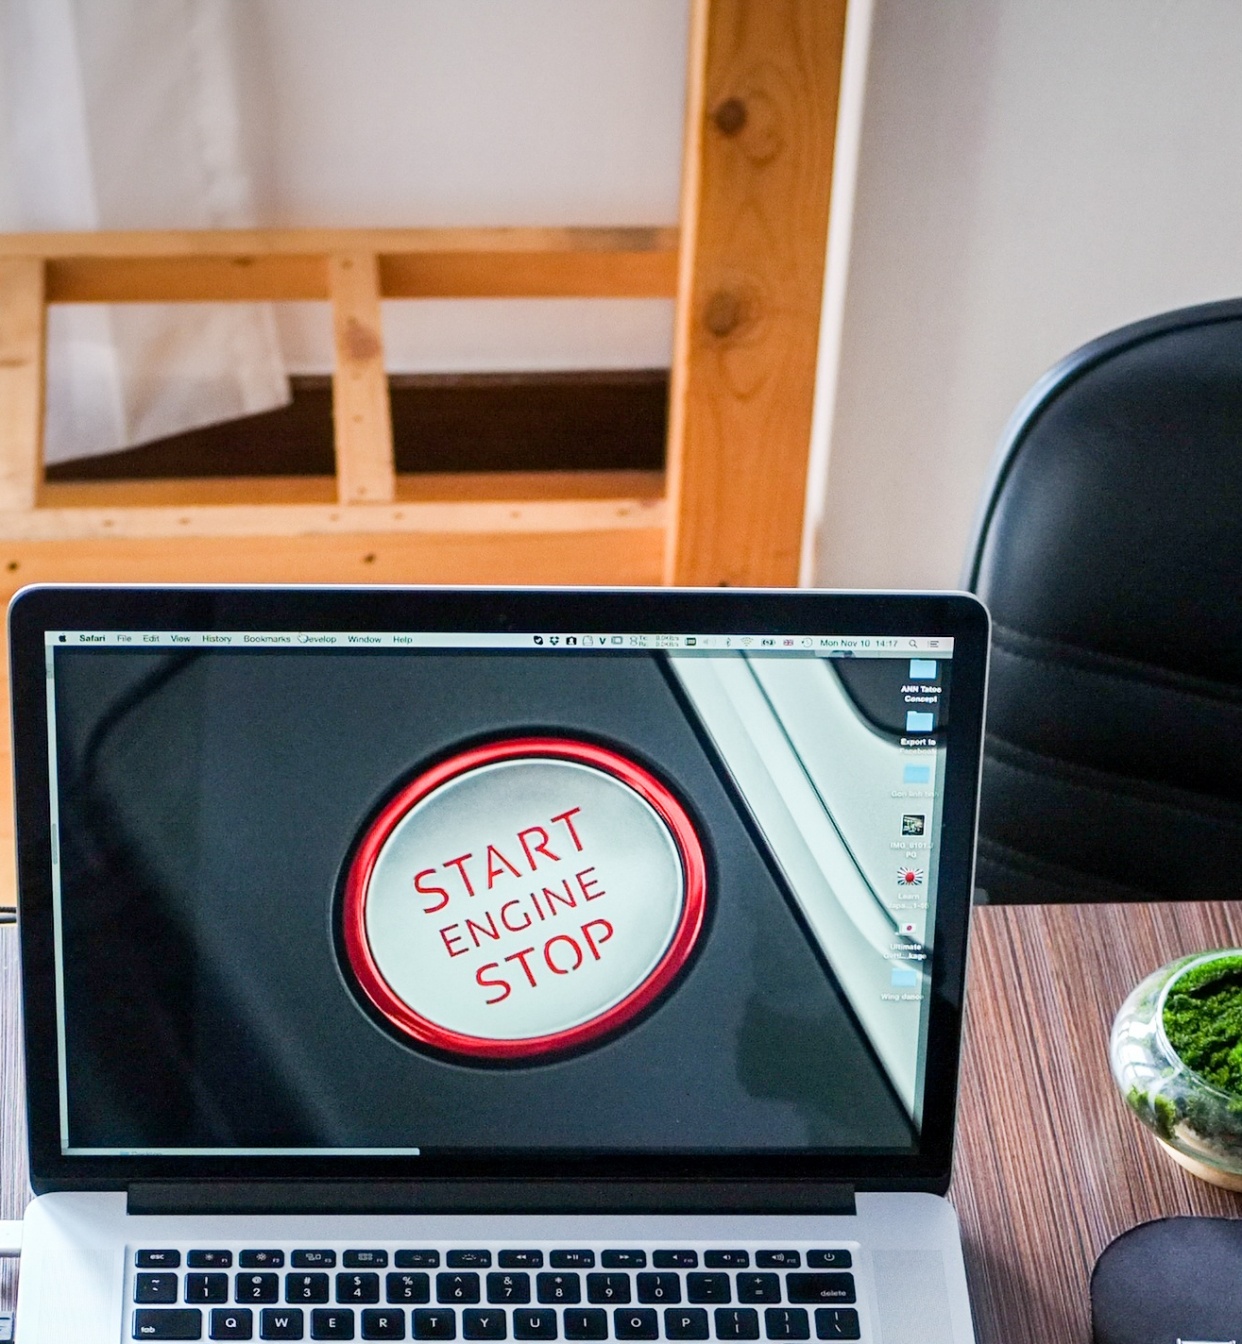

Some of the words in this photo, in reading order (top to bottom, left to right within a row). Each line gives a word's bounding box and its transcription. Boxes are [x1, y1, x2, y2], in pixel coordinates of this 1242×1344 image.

[79, 635, 106, 643] Safari
[117, 635, 132, 643] File
[143, 635, 160, 643] Edit
[171, 635, 191, 643] View
[202, 635, 232, 645] History
[244, 635, 291, 643] Bookmarks
[348, 635, 382, 644] Window
[393, 635, 413, 645] Help
[820, 639, 839, 647] Mon
[841, 639, 858, 648] Nov
[861, 640, 871, 648] 10
[876, 640, 898, 648] 14:17
[901, 685, 919, 693] ANN
[904, 695, 938, 704] Concept
[900, 738, 927, 747] Export
[414, 807, 583, 914] START
[898, 893, 920, 901] Learn
[439, 867, 606, 957] ENGINE
[890, 943, 921, 951] Ultimate
[475, 919, 614, 1005] STOP
[252, 1276, 262, 1284] @
[354, 1277, 361, 1285] $
[403, 1277, 413, 1285] %
[504, 1277, 512, 1285] &
[204, 1288, 208, 1296] 1
[253, 1288, 260, 1296] 2
[304, 1288, 311, 1297] 3
[354, 1288, 361, 1296] 4
[405, 1288, 411, 1297] 5
[455, 1288, 462, 1296] 6
[505, 1288, 512, 1296] 7
[556, 1288, 563, 1297] 8
[606, 1289, 612, 1297] 9
[655, 1288, 663, 1297] 0
[226, 1318, 236, 1327] Q
[275, 1318, 288, 1327] W
[329, 1318, 335, 1327] E
[380, 1318, 387, 1327] R
[430, 1318, 437, 1327] T
[481, 1318, 488, 1327] Y
[530, 1319, 540, 1327] U
[631, 1318, 641, 1327] O
[682, 1318, 690, 1327] P
